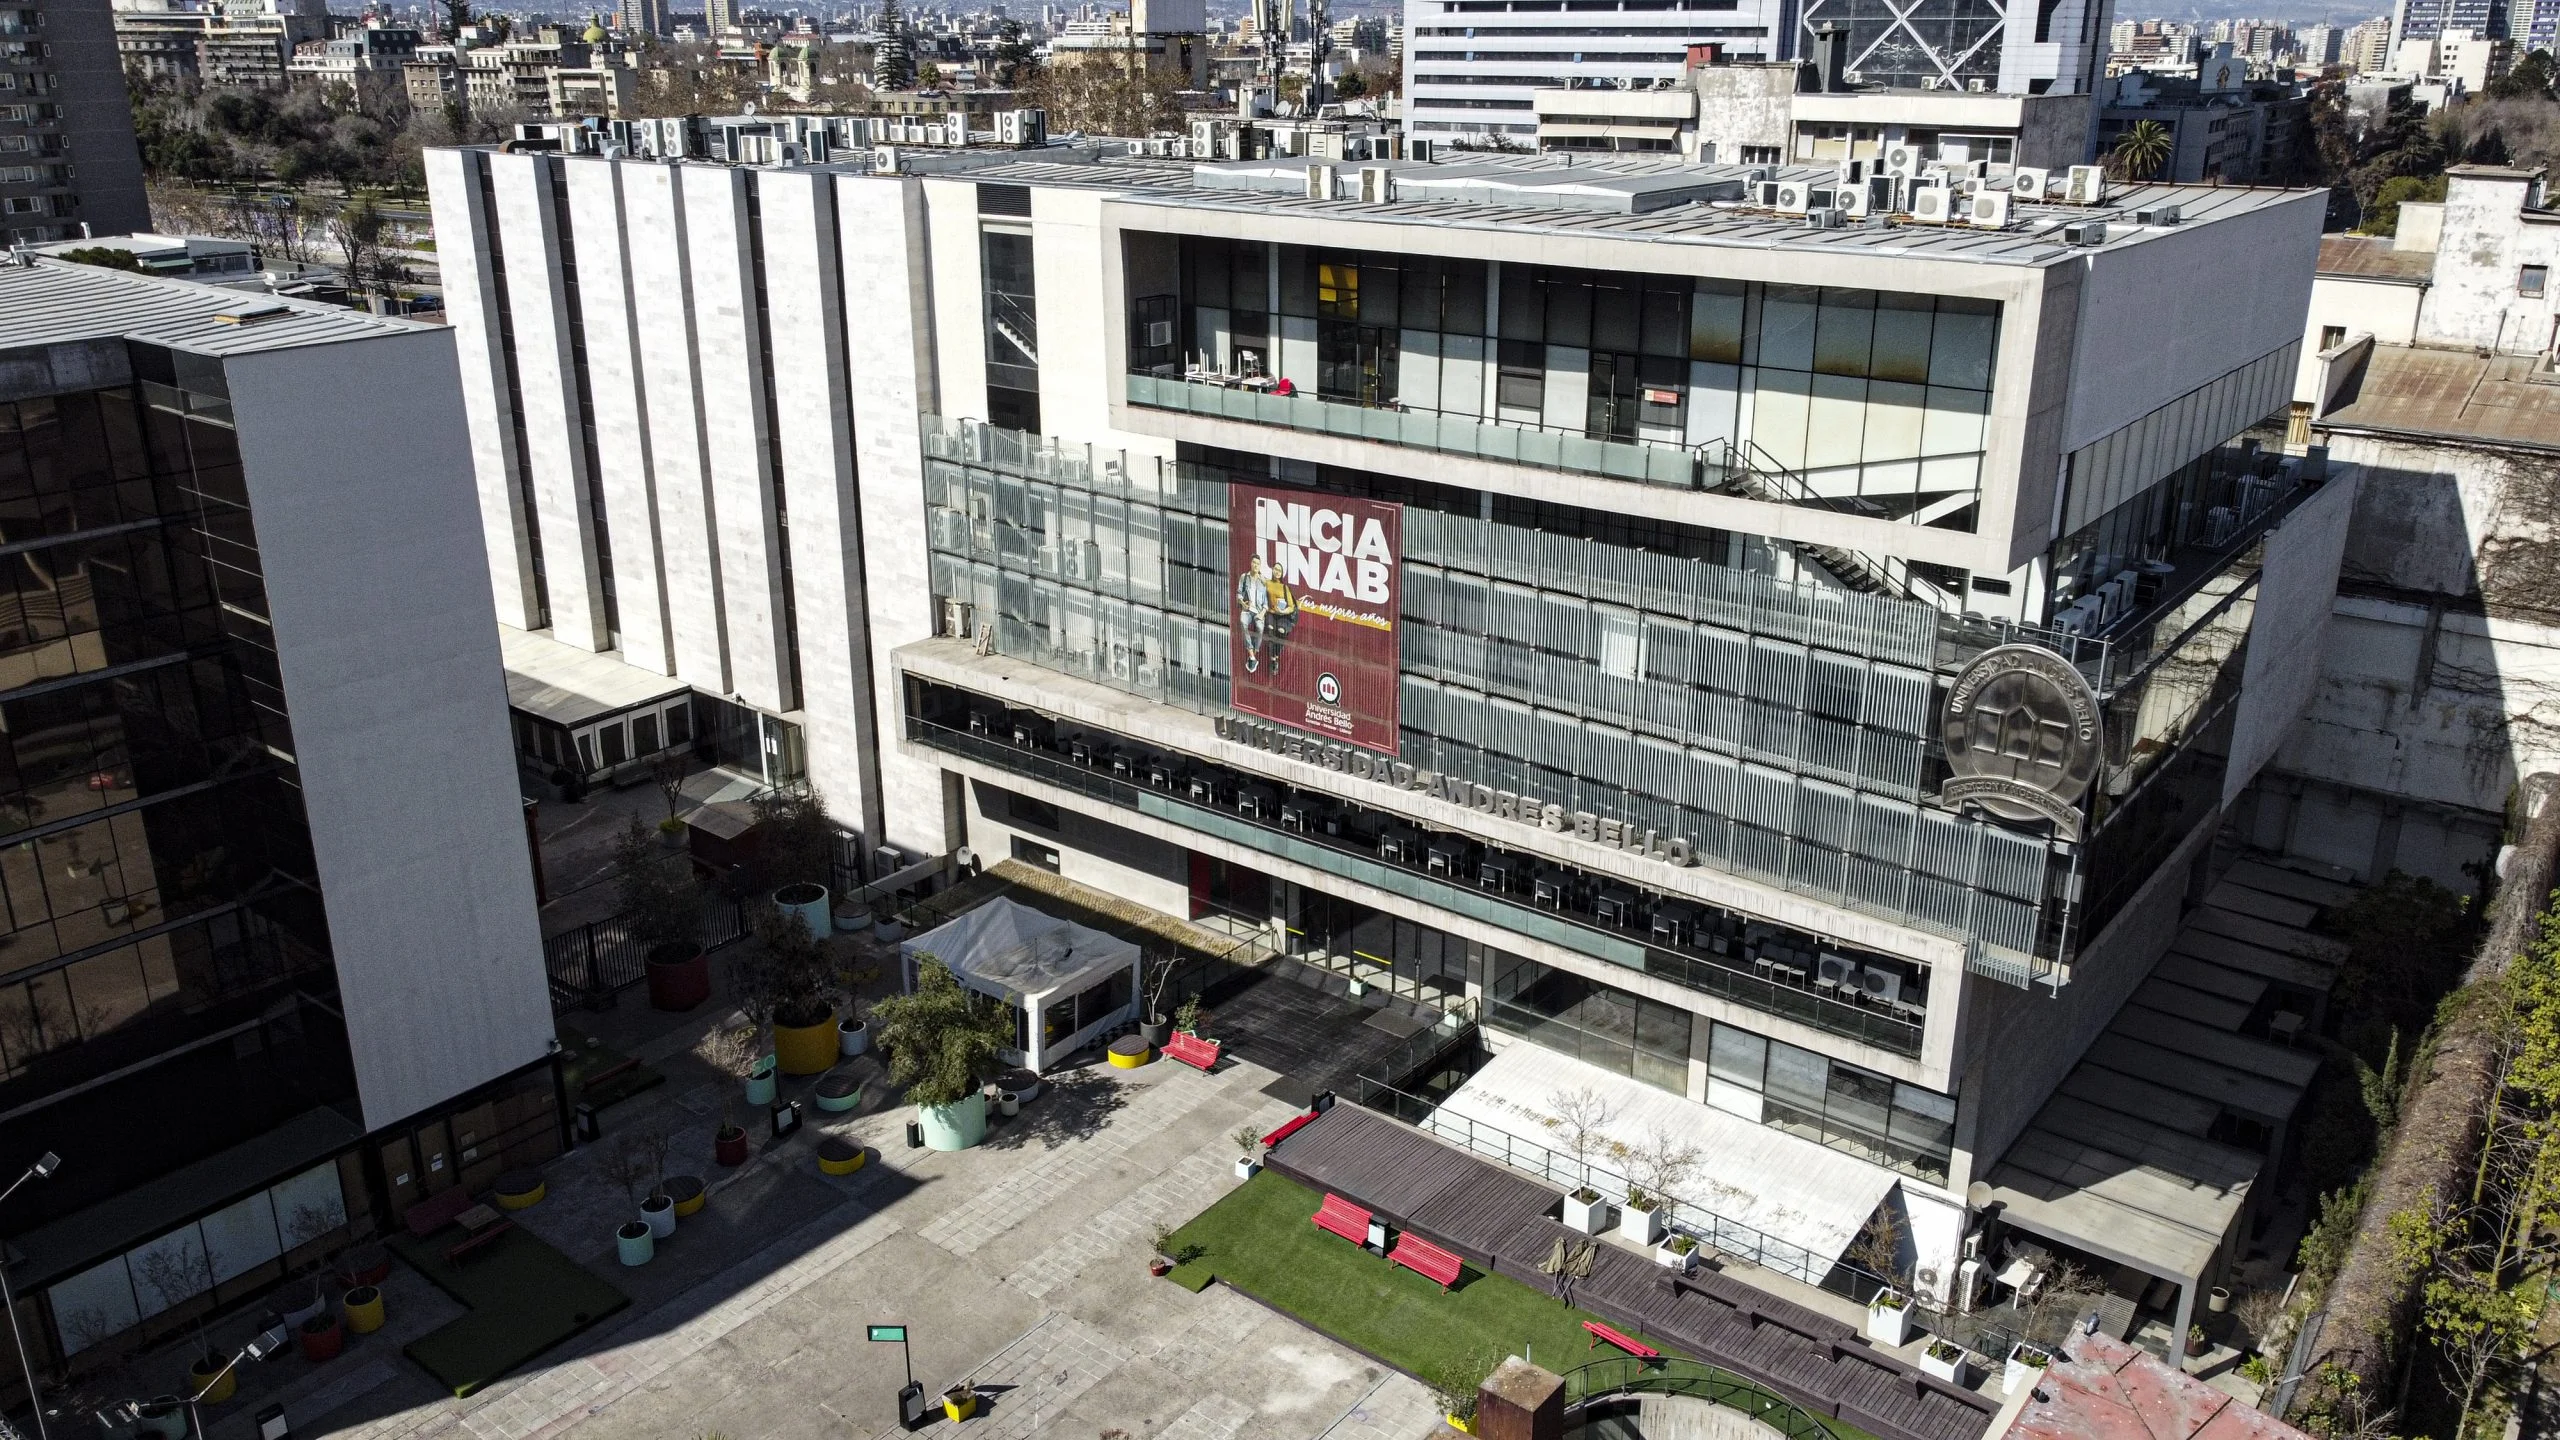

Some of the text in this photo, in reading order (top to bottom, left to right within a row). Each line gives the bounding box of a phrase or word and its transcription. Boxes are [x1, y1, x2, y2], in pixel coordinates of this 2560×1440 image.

[1256, 536, 1390, 604] UNAB
[1298, 595, 1388, 627] Tus mejores años
[1951, 653, 2021, 713] UNIVERSIDAD
[1306, 702, 1351, 720] Universidad
[1334, 717, 1353, 730] Bello
[1214, 715, 1694, 868] UNIVERSIDAD ANDRES BELLO
